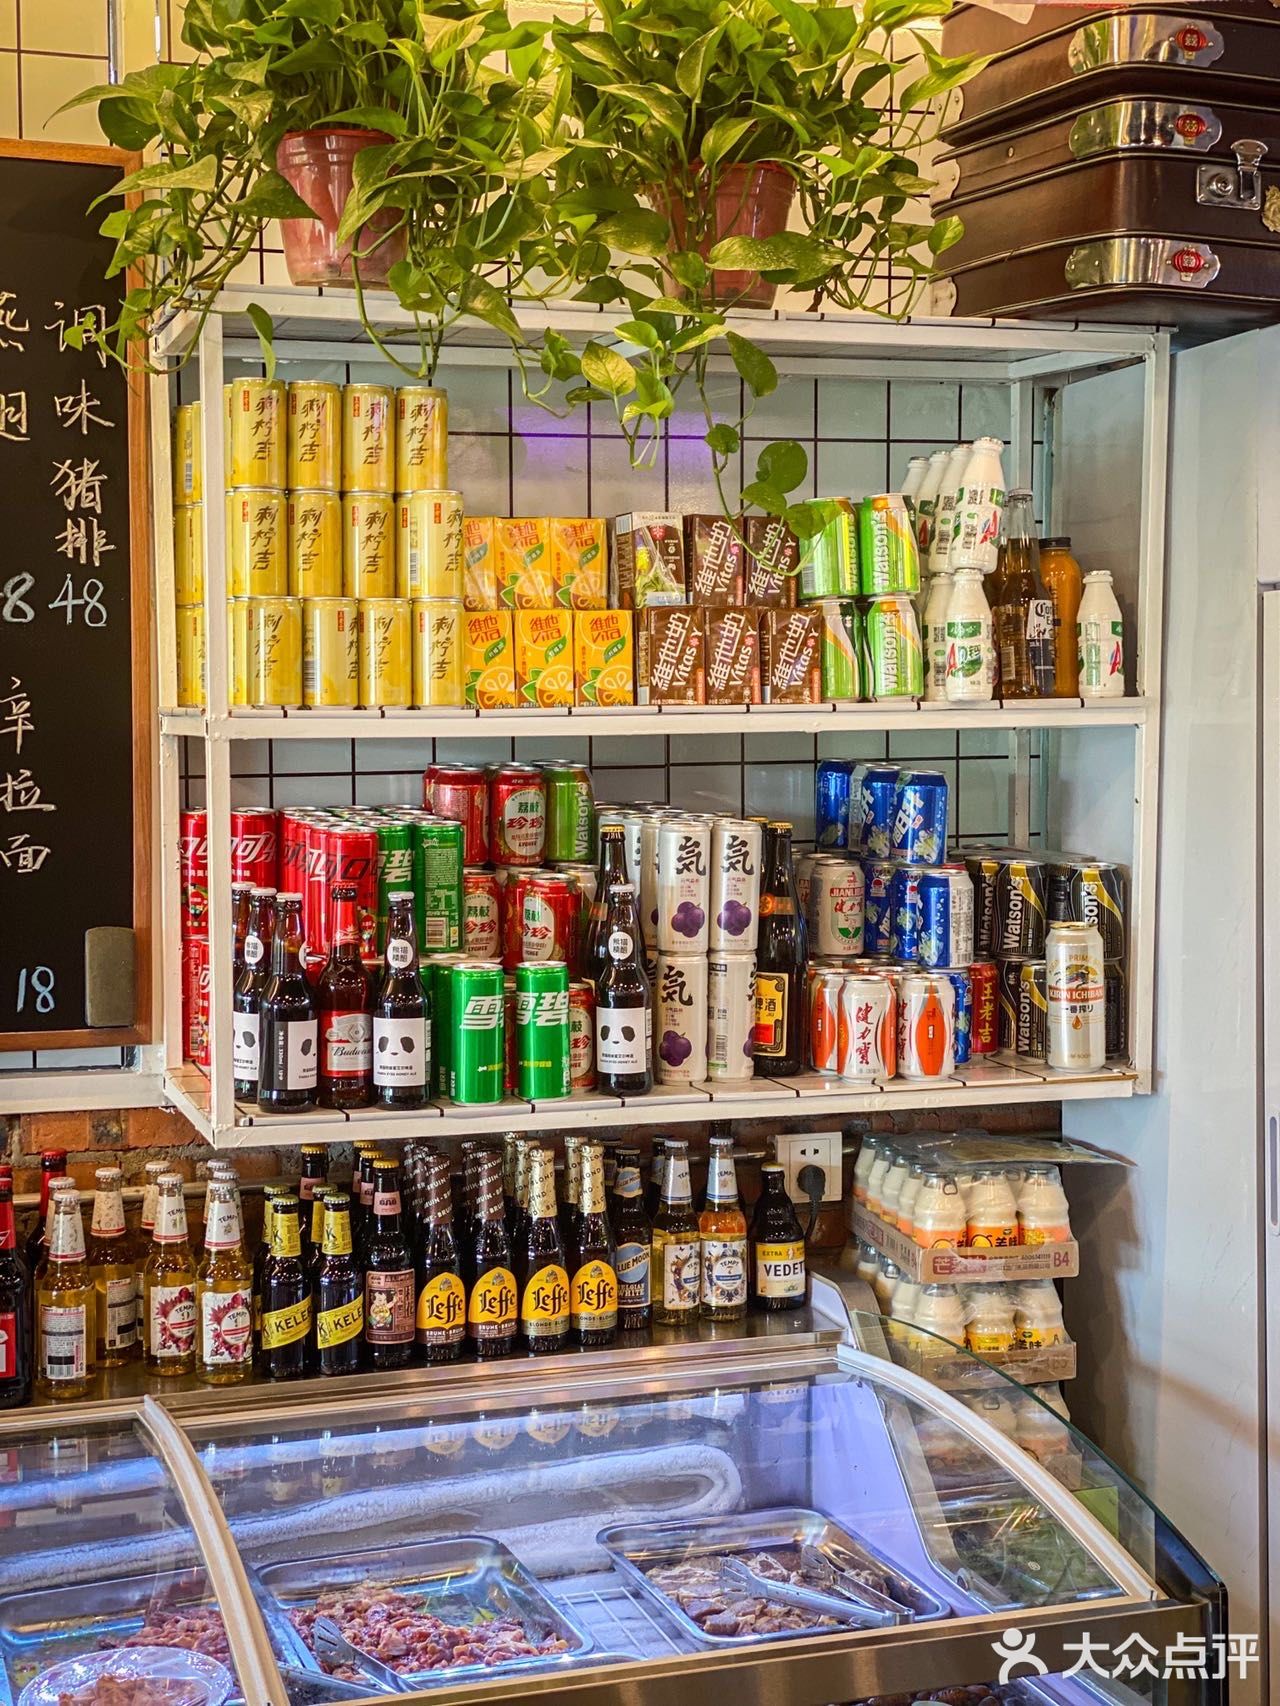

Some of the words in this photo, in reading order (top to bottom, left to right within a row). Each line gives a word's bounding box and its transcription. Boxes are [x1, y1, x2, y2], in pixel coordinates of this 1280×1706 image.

[298, 398, 326, 462] 刺柠吉
[406, 402, 435, 466] 刺柠吉
[251, 505, 279, 570] 刺柠吉
[296, 507, 322, 571] 刺柠吉
[361, 510, 388, 573] 刺柠吉
[0, 572, 36, 624] 8
[48, 573, 108, 627] 48
[429, 616, 455, 680] 刺柠吉
[650, 612, 692, 691] 維他奶
[707, 612, 746, 691] 維他奶
[506, 815, 545, 830] 珍珍
[1003, 876, 1024, 950] Watson's
[16, 965, 56, 1013] 18
[459, 994, 504, 1031] 雪
[978, 982, 995, 1043] 王老吉
[1017, 980, 1032, 1052] Watson's
[617, 1260, 631, 1272] LUE
[720, 1260, 739, 1268] TEMPT
[763, 1261, 805, 1278] VEDET
[1053, 1251, 1070, 1268] B4
[426, 1291, 463, 1325] Leffe
[478, 1286, 515, 1319] Leffe
[531, 1283, 568, 1317] Leffe
[576, 1279, 615, 1311] Leffe
